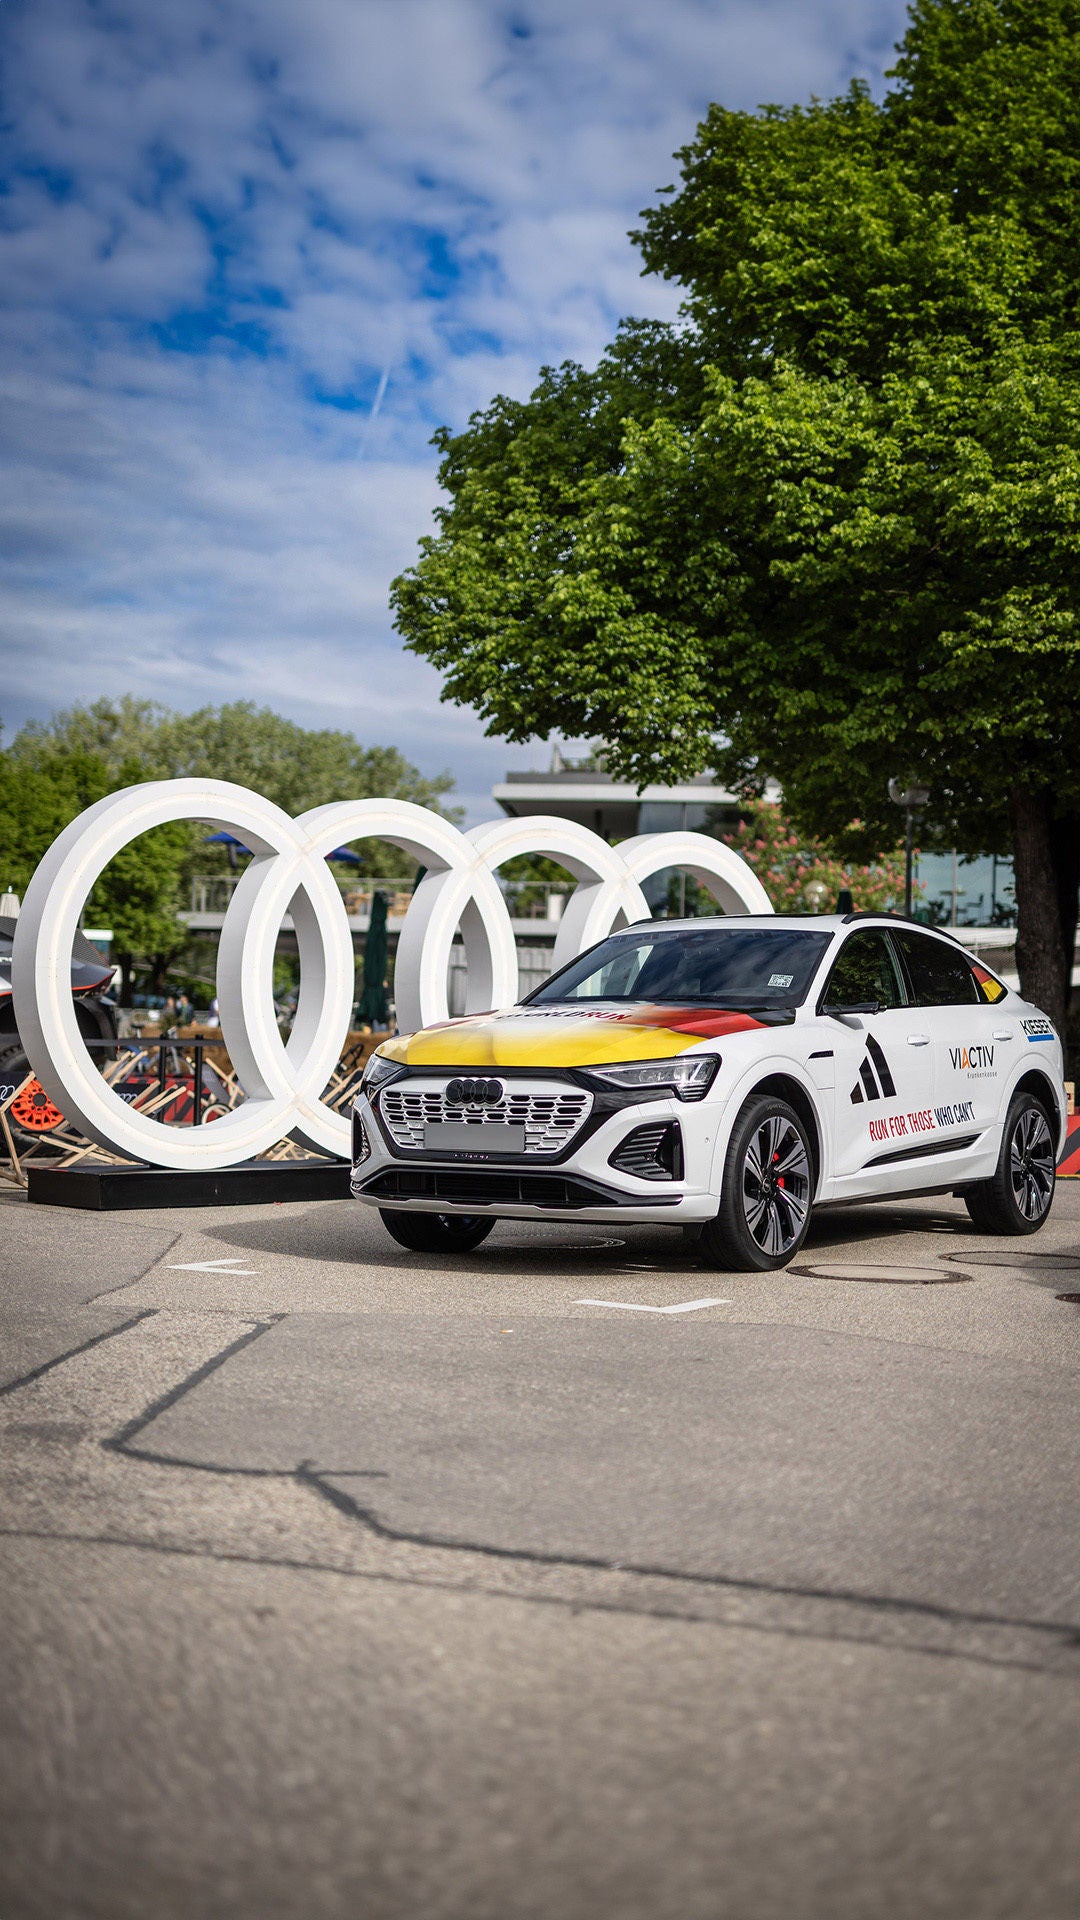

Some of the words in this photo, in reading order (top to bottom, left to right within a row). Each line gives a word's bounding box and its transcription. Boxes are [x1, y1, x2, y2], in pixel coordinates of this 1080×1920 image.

[949, 1045, 994, 1069] VIACTIV
[869, 1118, 890, 1141] RUN
[889, 1115, 909, 1138] FOR
[907, 1109, 935, 1133] THOSE
[934, 1105, 955, 1128] WHO
[953, 1101, 975, 1123] CAN'T
